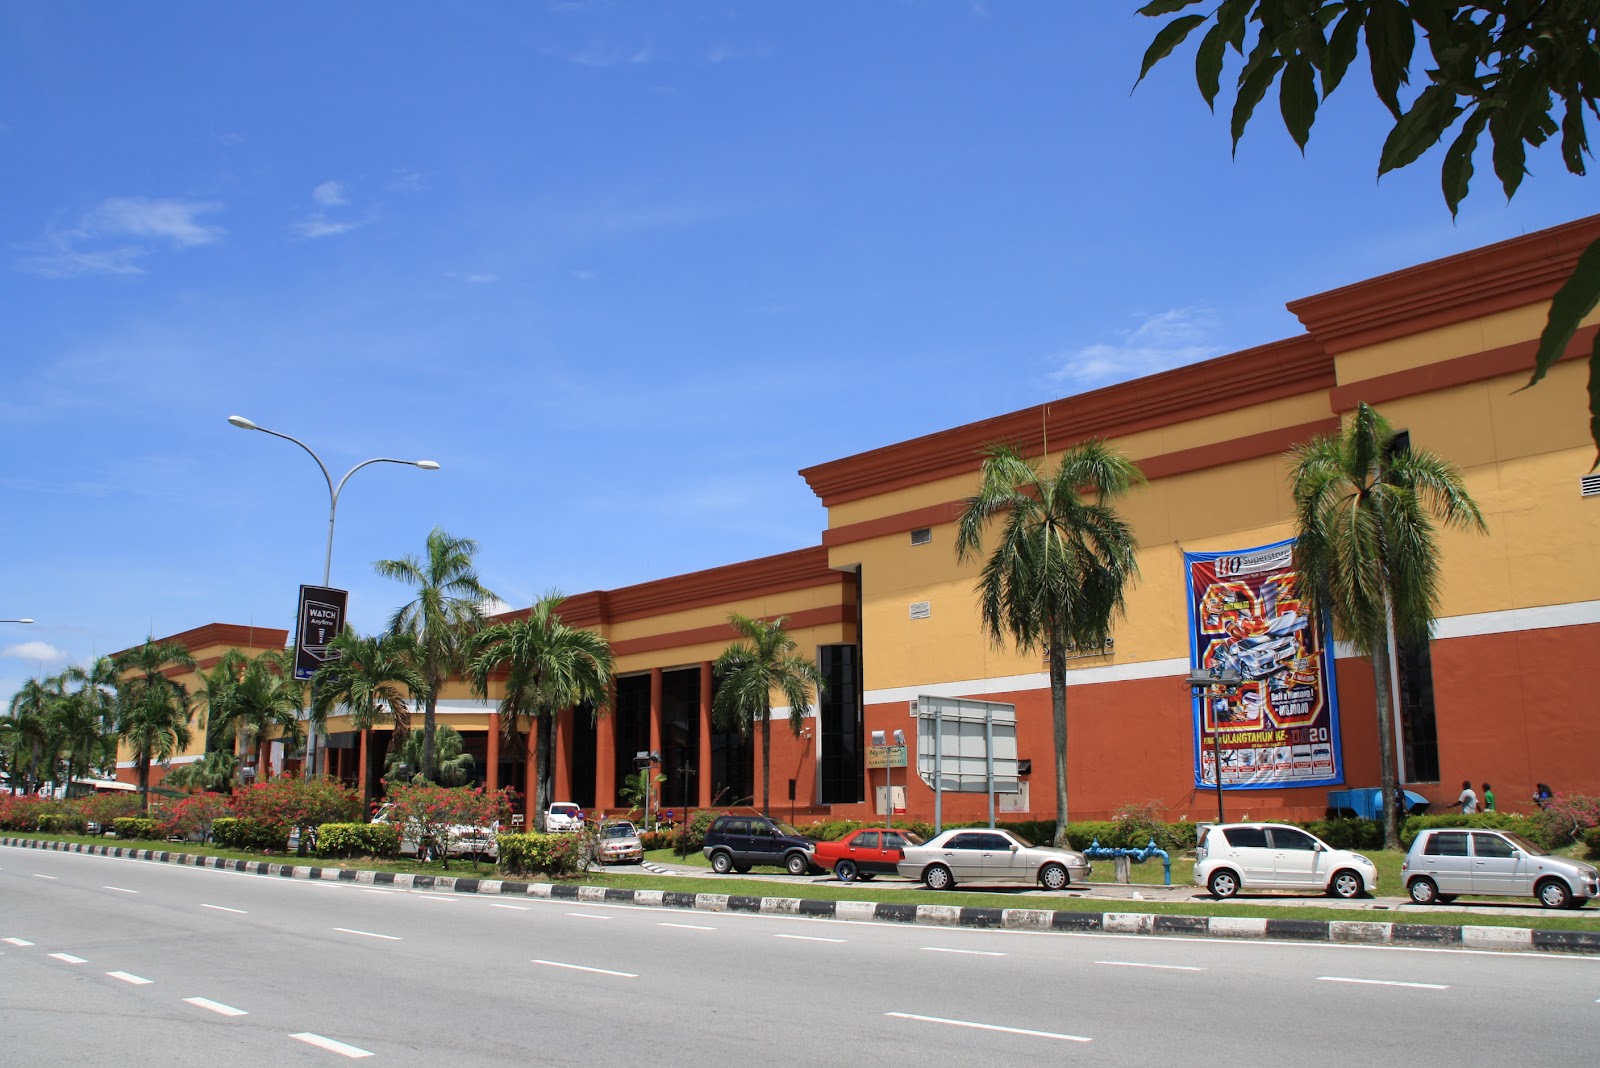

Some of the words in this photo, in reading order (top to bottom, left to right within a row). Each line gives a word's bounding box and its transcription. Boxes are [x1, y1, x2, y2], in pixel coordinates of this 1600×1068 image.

[1242, 549, 1290, 566] Superstore
[310, 609, 336, 619] WATCH
[1222, 731, 1274, 744] ULANGTAHUN
